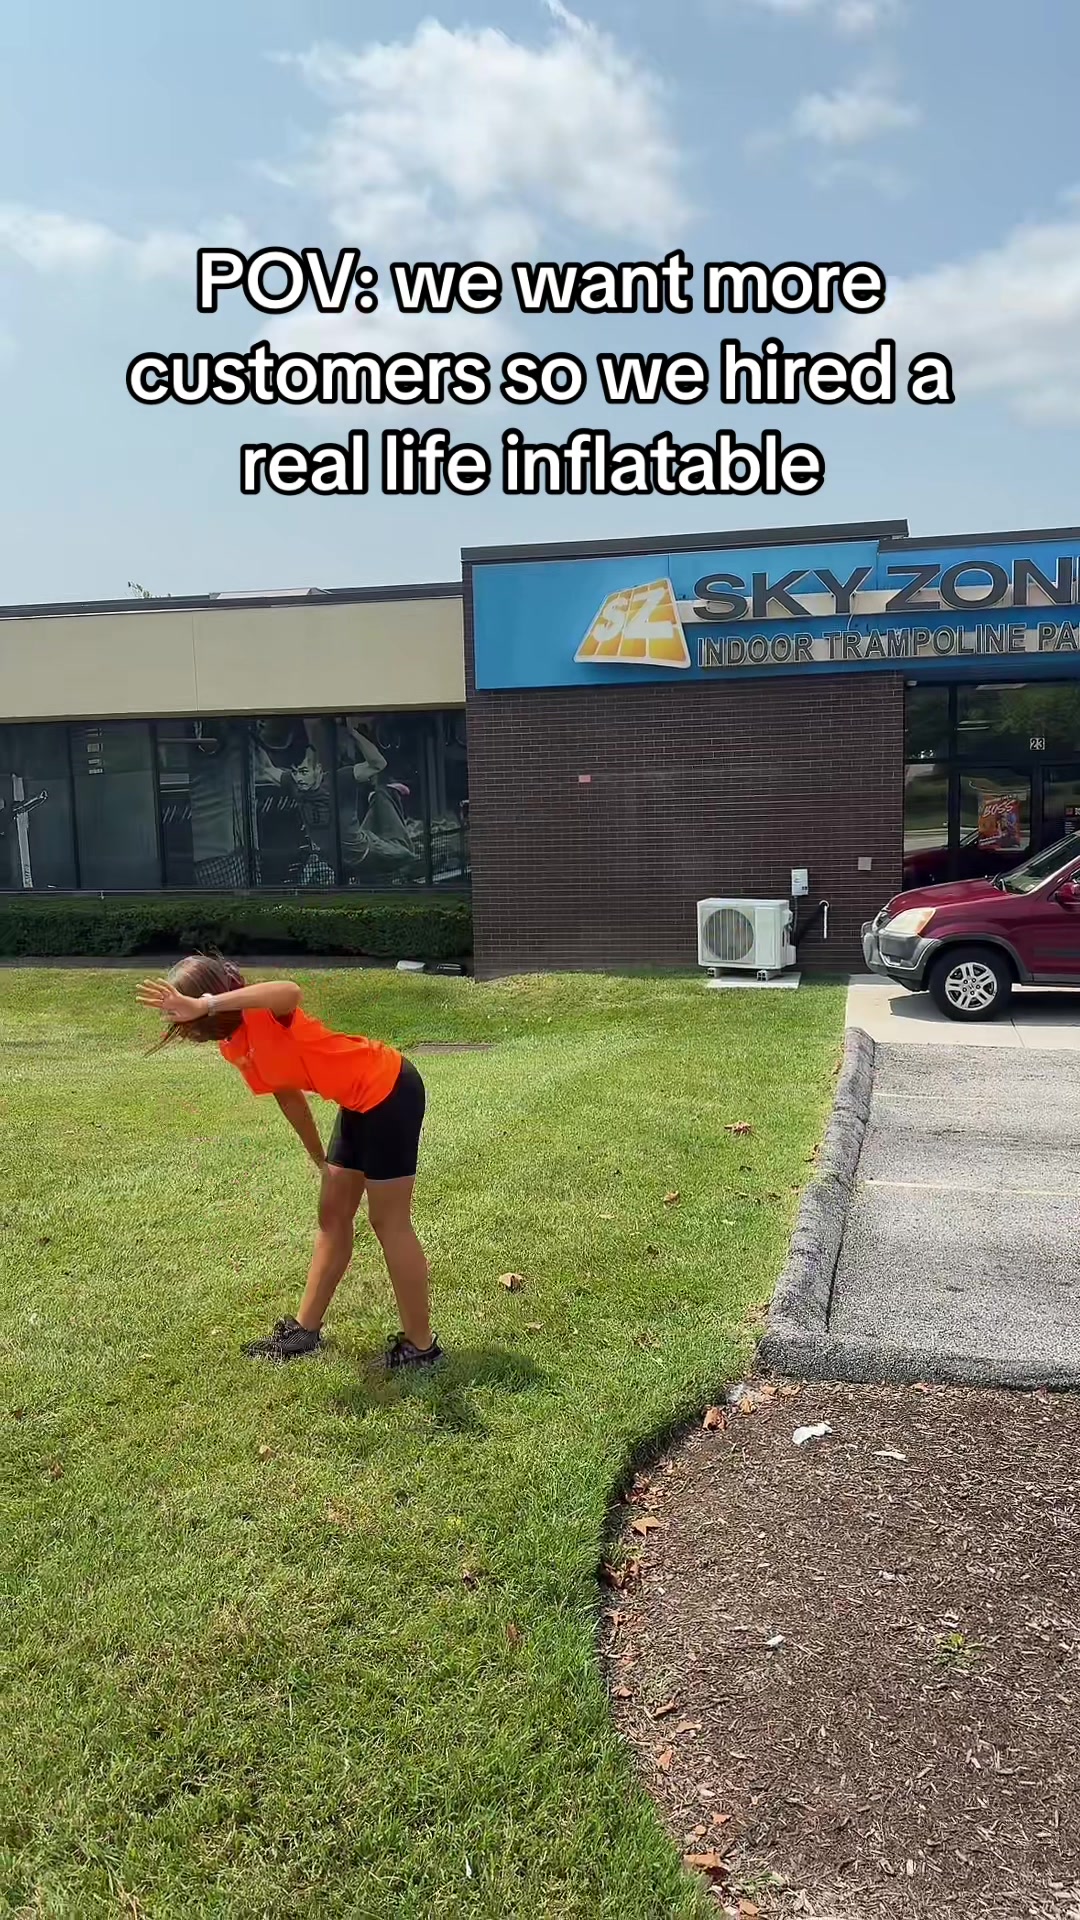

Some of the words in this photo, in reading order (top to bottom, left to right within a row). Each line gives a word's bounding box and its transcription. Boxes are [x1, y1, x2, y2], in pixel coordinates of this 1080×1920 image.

[693, 566, 873, 621] SKY
[885, 556, 1080, 610] ZON
[591, 587, 674, 642] SZ
[697, 632, 815, 667] INDOOR
[823, 622, 1027, 660] TRAMPOLINE
[1037, 621, 1080, 652] PA
[1030, 738, 1045, 750] 23
